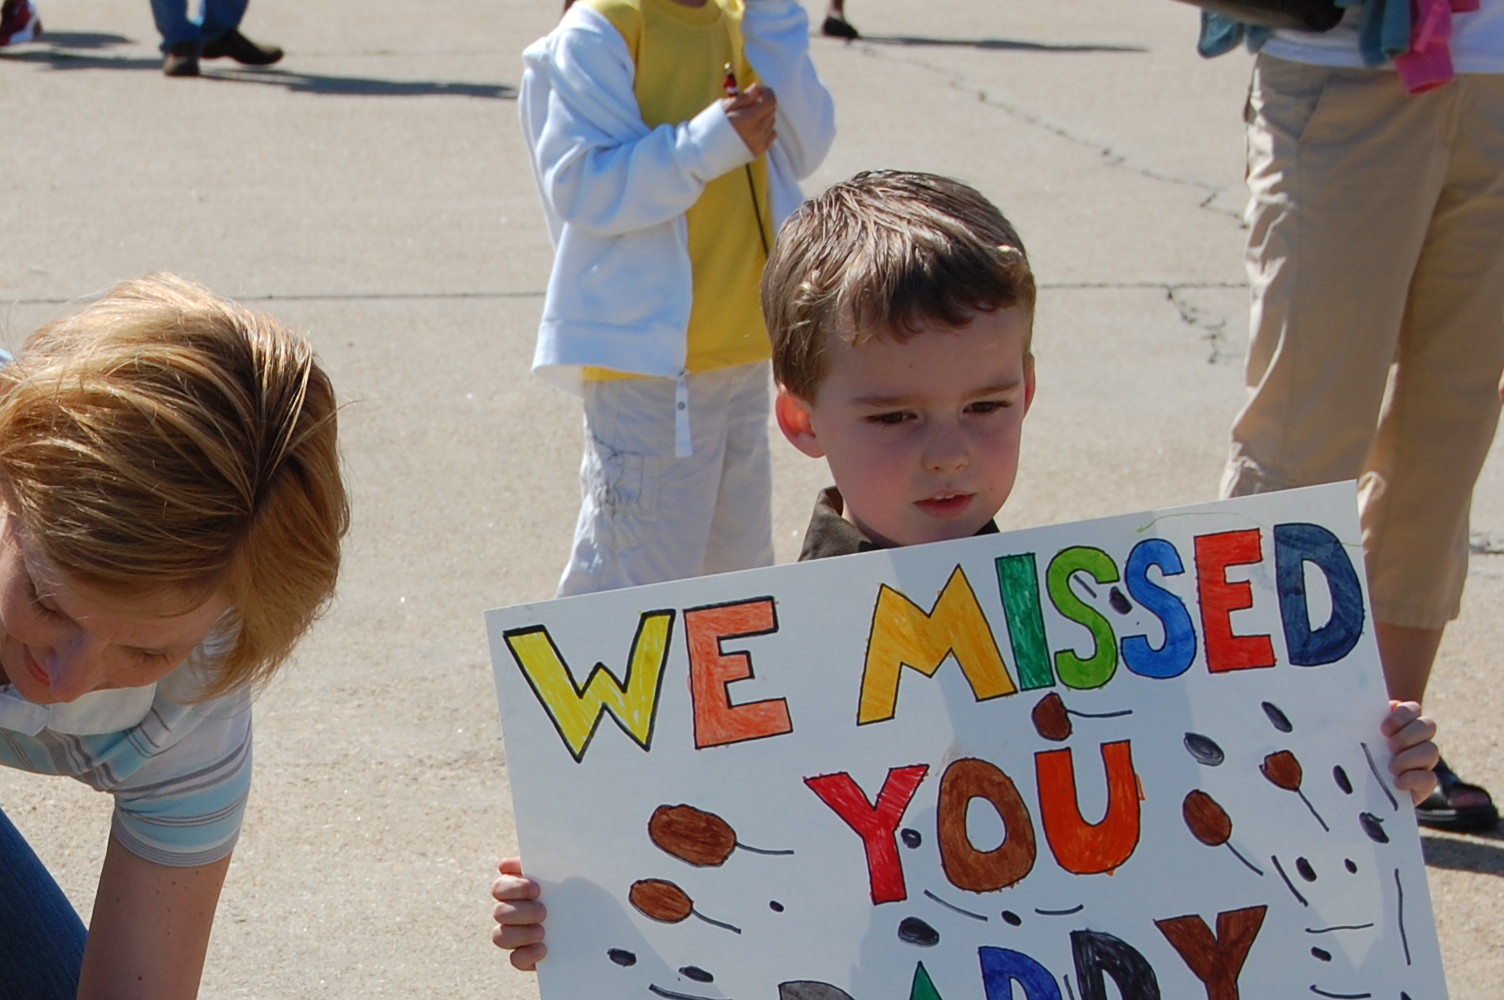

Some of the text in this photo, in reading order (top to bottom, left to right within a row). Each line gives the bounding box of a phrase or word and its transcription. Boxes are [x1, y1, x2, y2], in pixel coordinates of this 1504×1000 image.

[502, 522, 1367, 763] WE MISSED
[803, 739, 1141, 906] YOU
